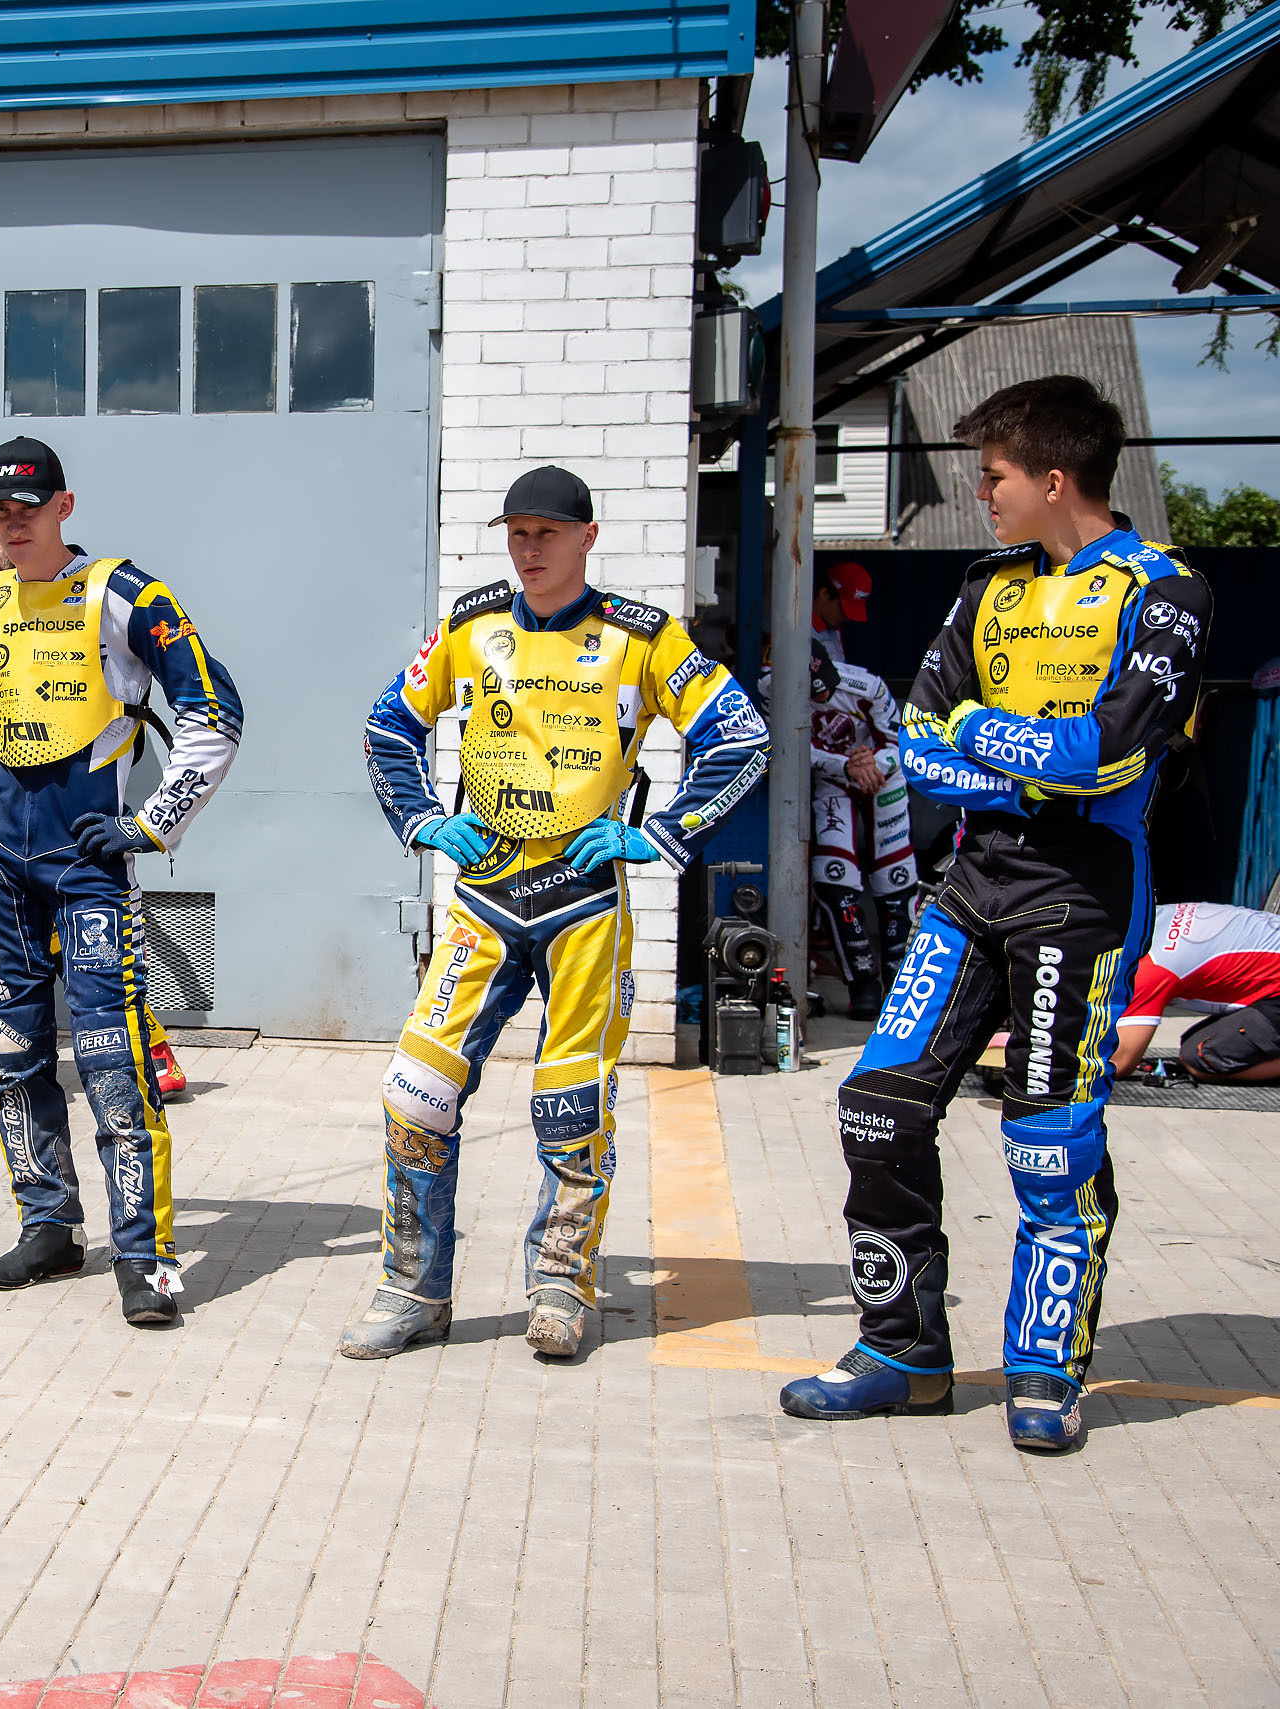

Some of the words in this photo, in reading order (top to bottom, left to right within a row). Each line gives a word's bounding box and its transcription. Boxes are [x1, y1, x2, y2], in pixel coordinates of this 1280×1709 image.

[451, 586, 509, 619] CANAL+
[624, 604, 661, 624] mjp
[2, 616, 86, 637] spechouse
[1003, 622, 1099, 643] spechouse
[33, 649, 68, 661] Imex
[993, 662, 1006, 675] PZU
[1036, 661, 1077, 675] Imex
[55, 681, 88, 695] mjp
[505, 675, 604, 695] spechouse
[496, 708, 508, 721] PZU
[542, 710, 582, 725] Imex
[476, 750, 528, 761] NOVOTEL
[565, 747, 602, 765] mjp
[564, 763, 601, 772] drukarnia
[708, 752, 767, 812] TUSCHE
[1027, 945, 1064, 1095] BOGDANKA
[81, 1032, 122, 1050] PERŁA
[392, 1072, 450, 1114] faurecia
[534, 1094, 595, 1118] STAL
[839, 1107, 895, 1128] lubelskie
[545, 1122, 587, 1135] SYSTEM
[1004, 1145, 1062, 1170] PERŁA
[401, 1183, 413, 1227] BROKE
[853, 1246, 888, 1264] Lactex
[857, 1275, 891, 1289] POLAND
